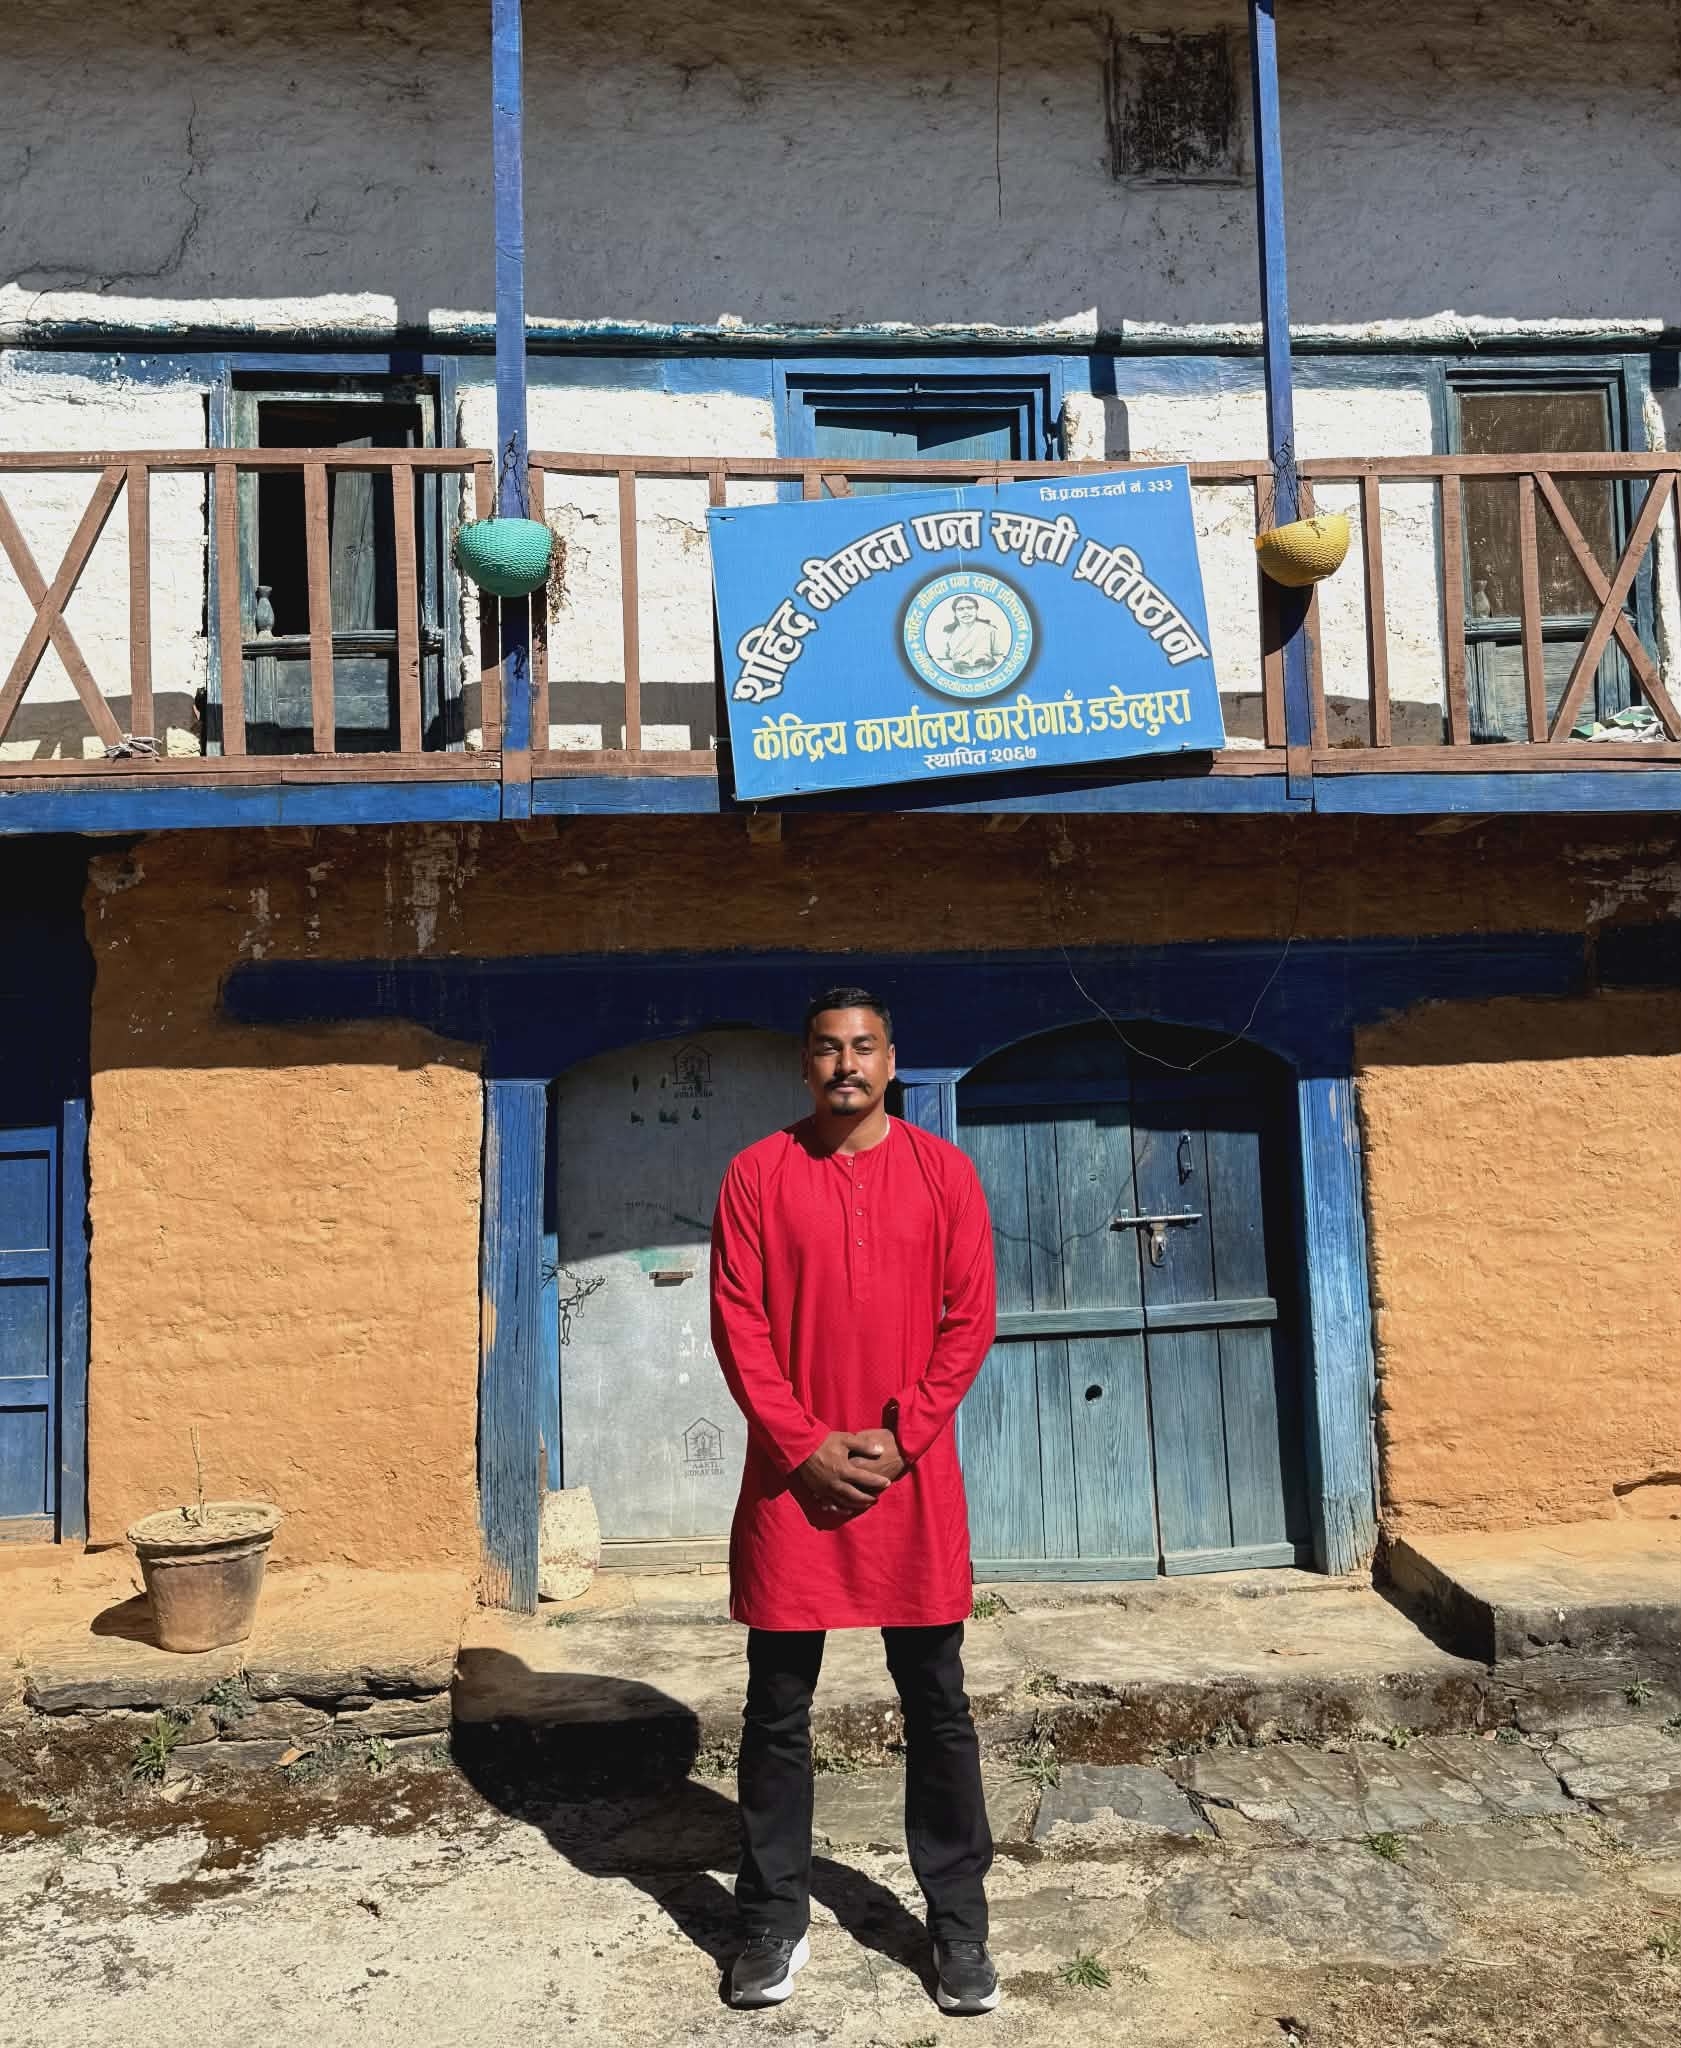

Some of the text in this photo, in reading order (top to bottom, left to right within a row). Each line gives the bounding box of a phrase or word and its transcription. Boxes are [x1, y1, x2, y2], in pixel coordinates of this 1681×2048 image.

[1148, 479, 1173, 493] ३३३
[732, 598, 818, 702] शहिद
[794, 522, 912, 611] भीमदत्त
[910, 511, 983, 551] पन्त
[991, 511, 1080, 566] स्मृती
[1073, 540, 1209, 665] प्रतिष्ठान
[752, 712, 847, 763] केन्द्रिय
[924, 747, 987, 770] स्थापित
